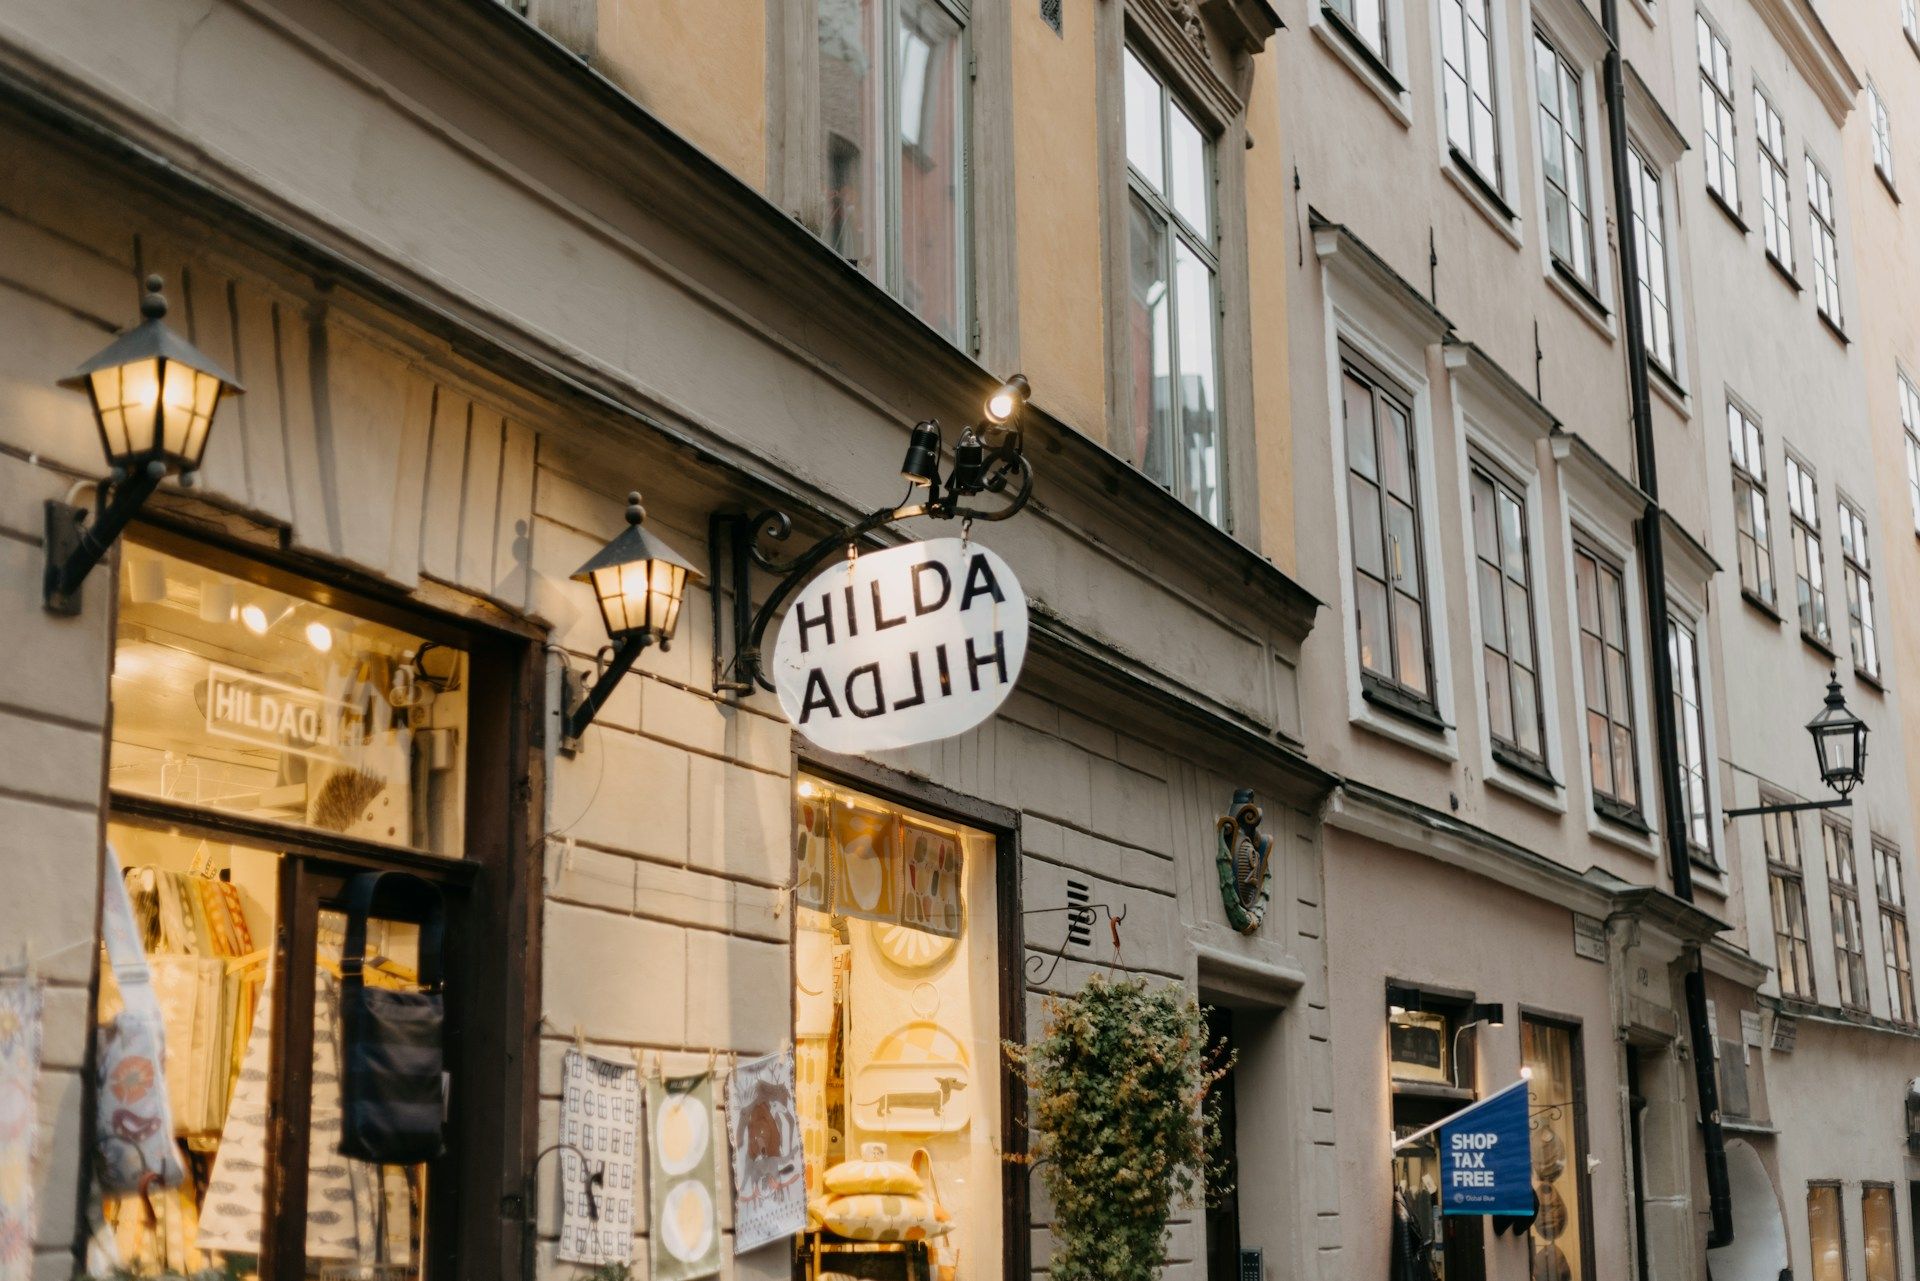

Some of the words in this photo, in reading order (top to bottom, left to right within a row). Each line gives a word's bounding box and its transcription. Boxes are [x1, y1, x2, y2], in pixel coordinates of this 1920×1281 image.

[795, 553, 1006, 653] HILDA
[1451, 1133, 1498, 1150] SHOP
[1451, 1152, 1485, 1169] TAX
[1453, 1170, 1495, 1187] FREE
